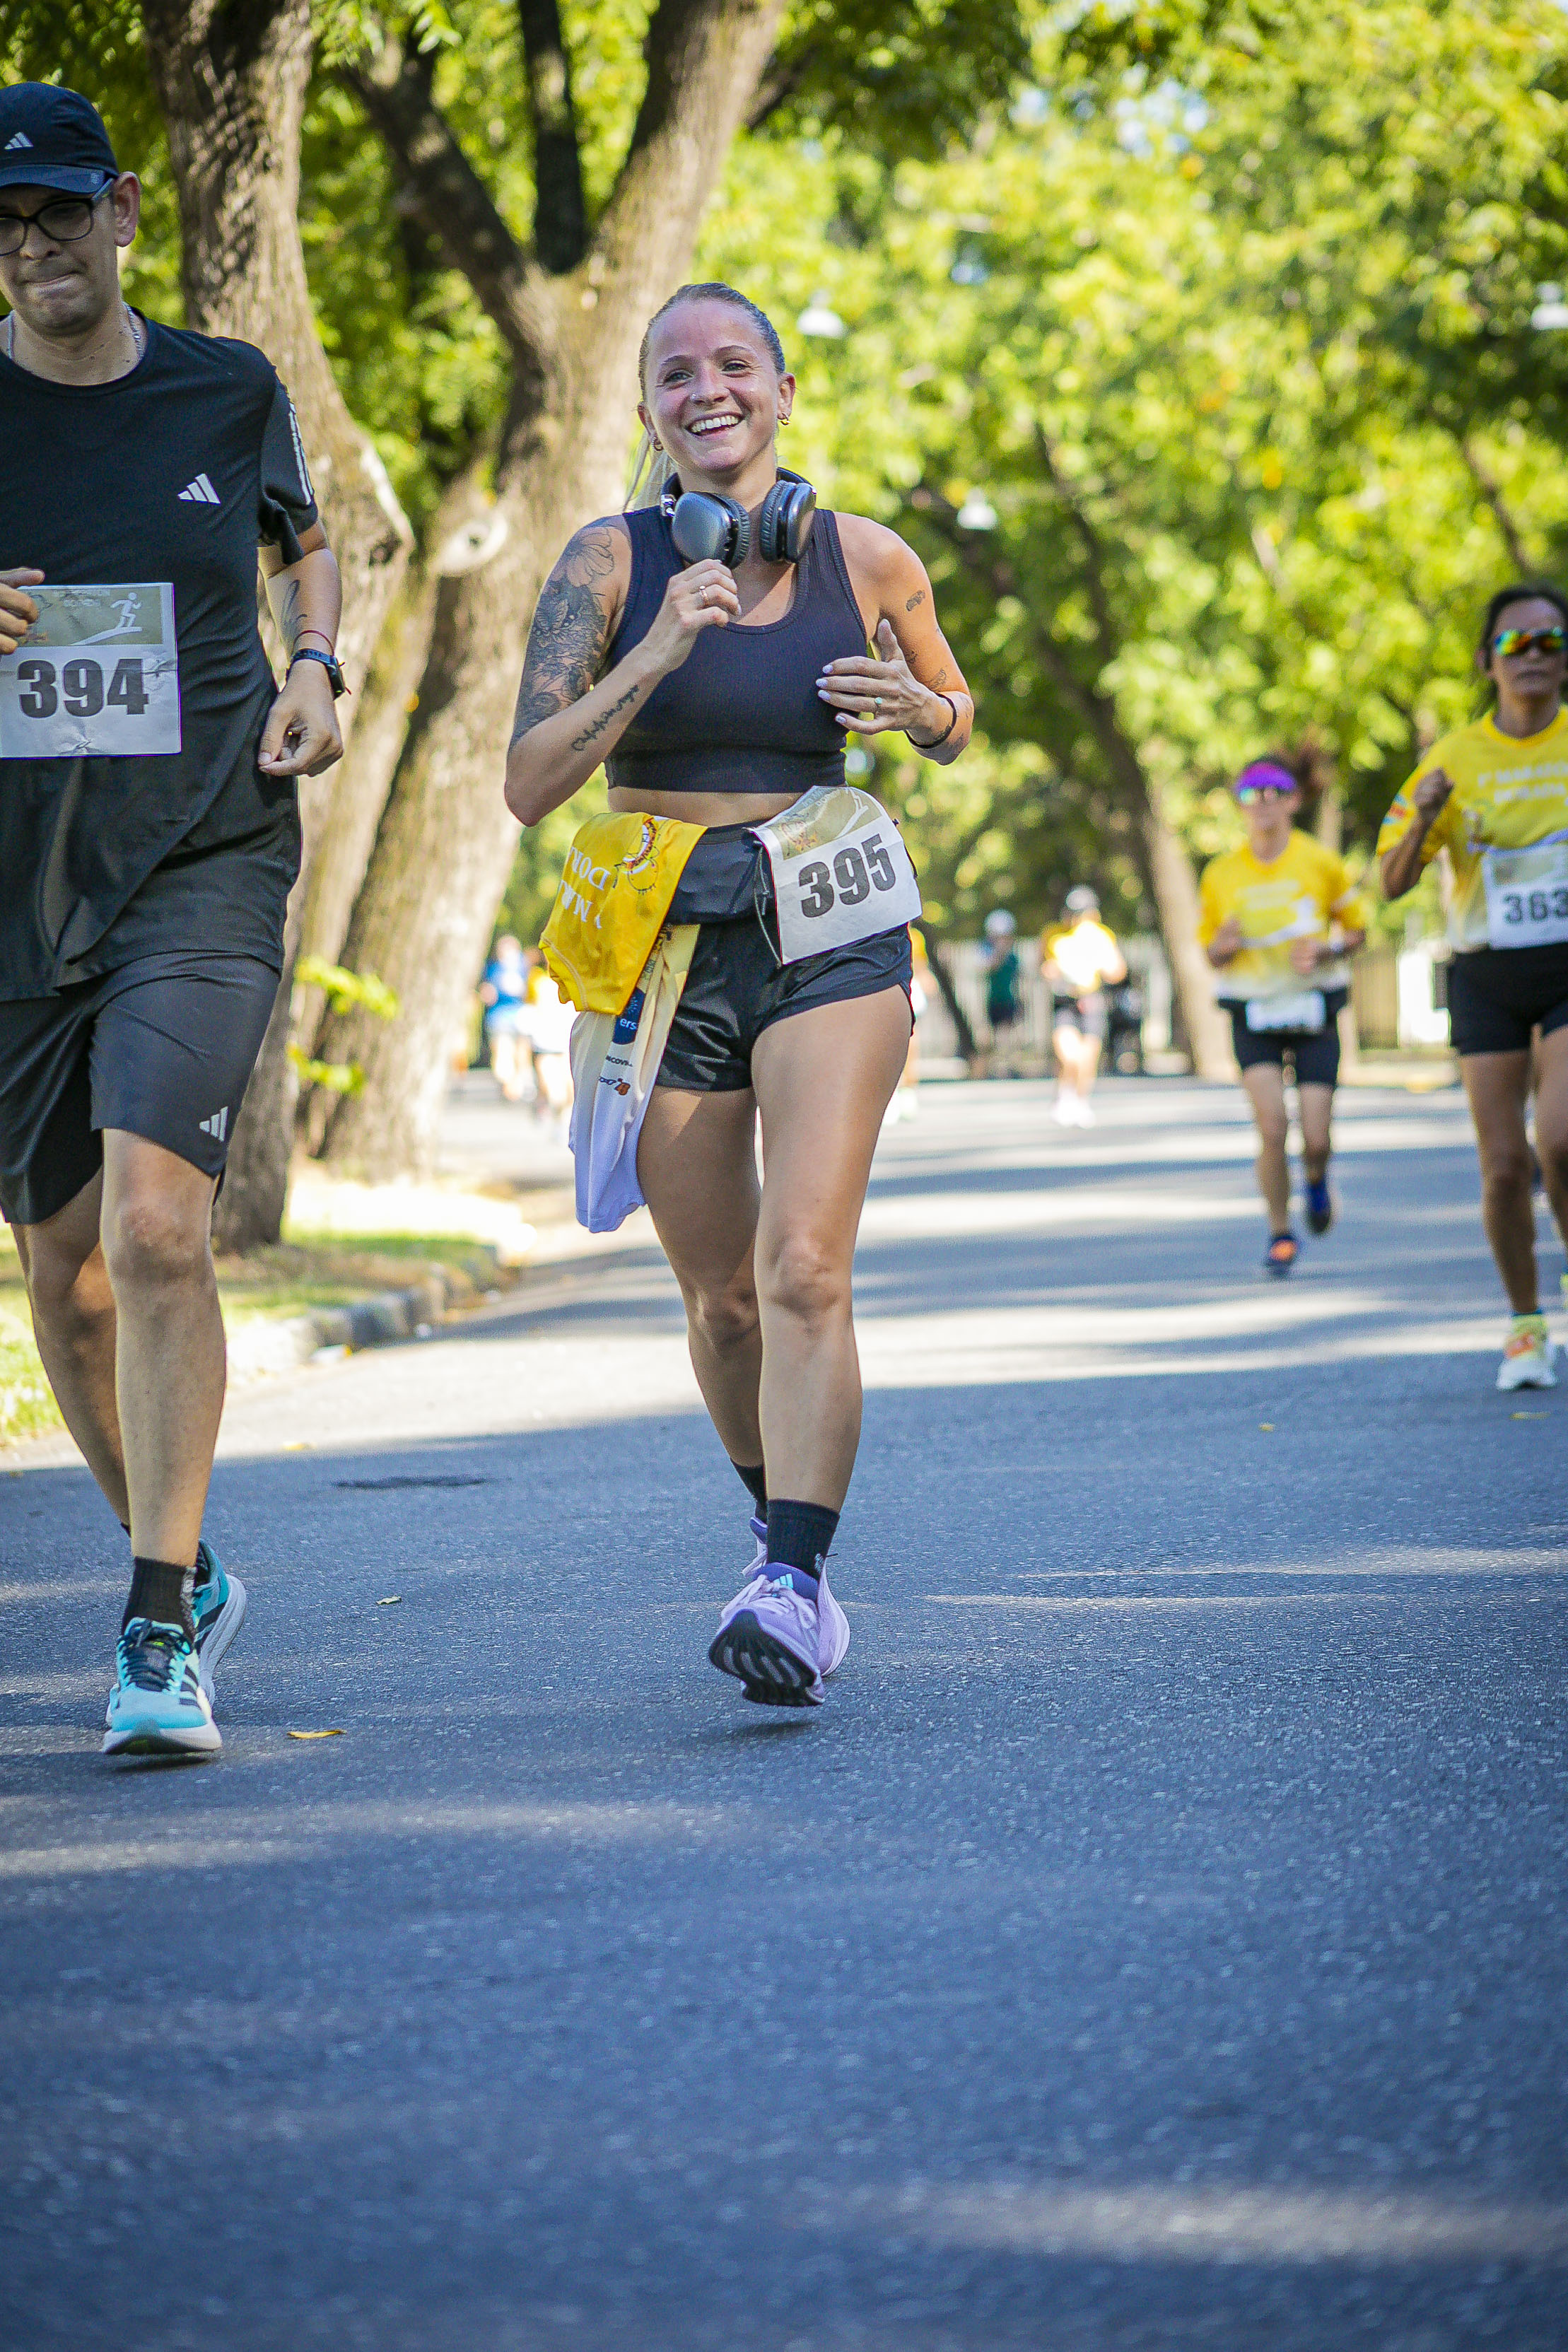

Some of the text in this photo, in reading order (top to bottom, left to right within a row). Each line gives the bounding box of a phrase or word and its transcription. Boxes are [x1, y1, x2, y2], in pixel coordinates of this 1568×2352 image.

[17, 658, 150, 718] 394
[799, 833, 896, 918] 395
[1504, 888, 1568, 923] 363
